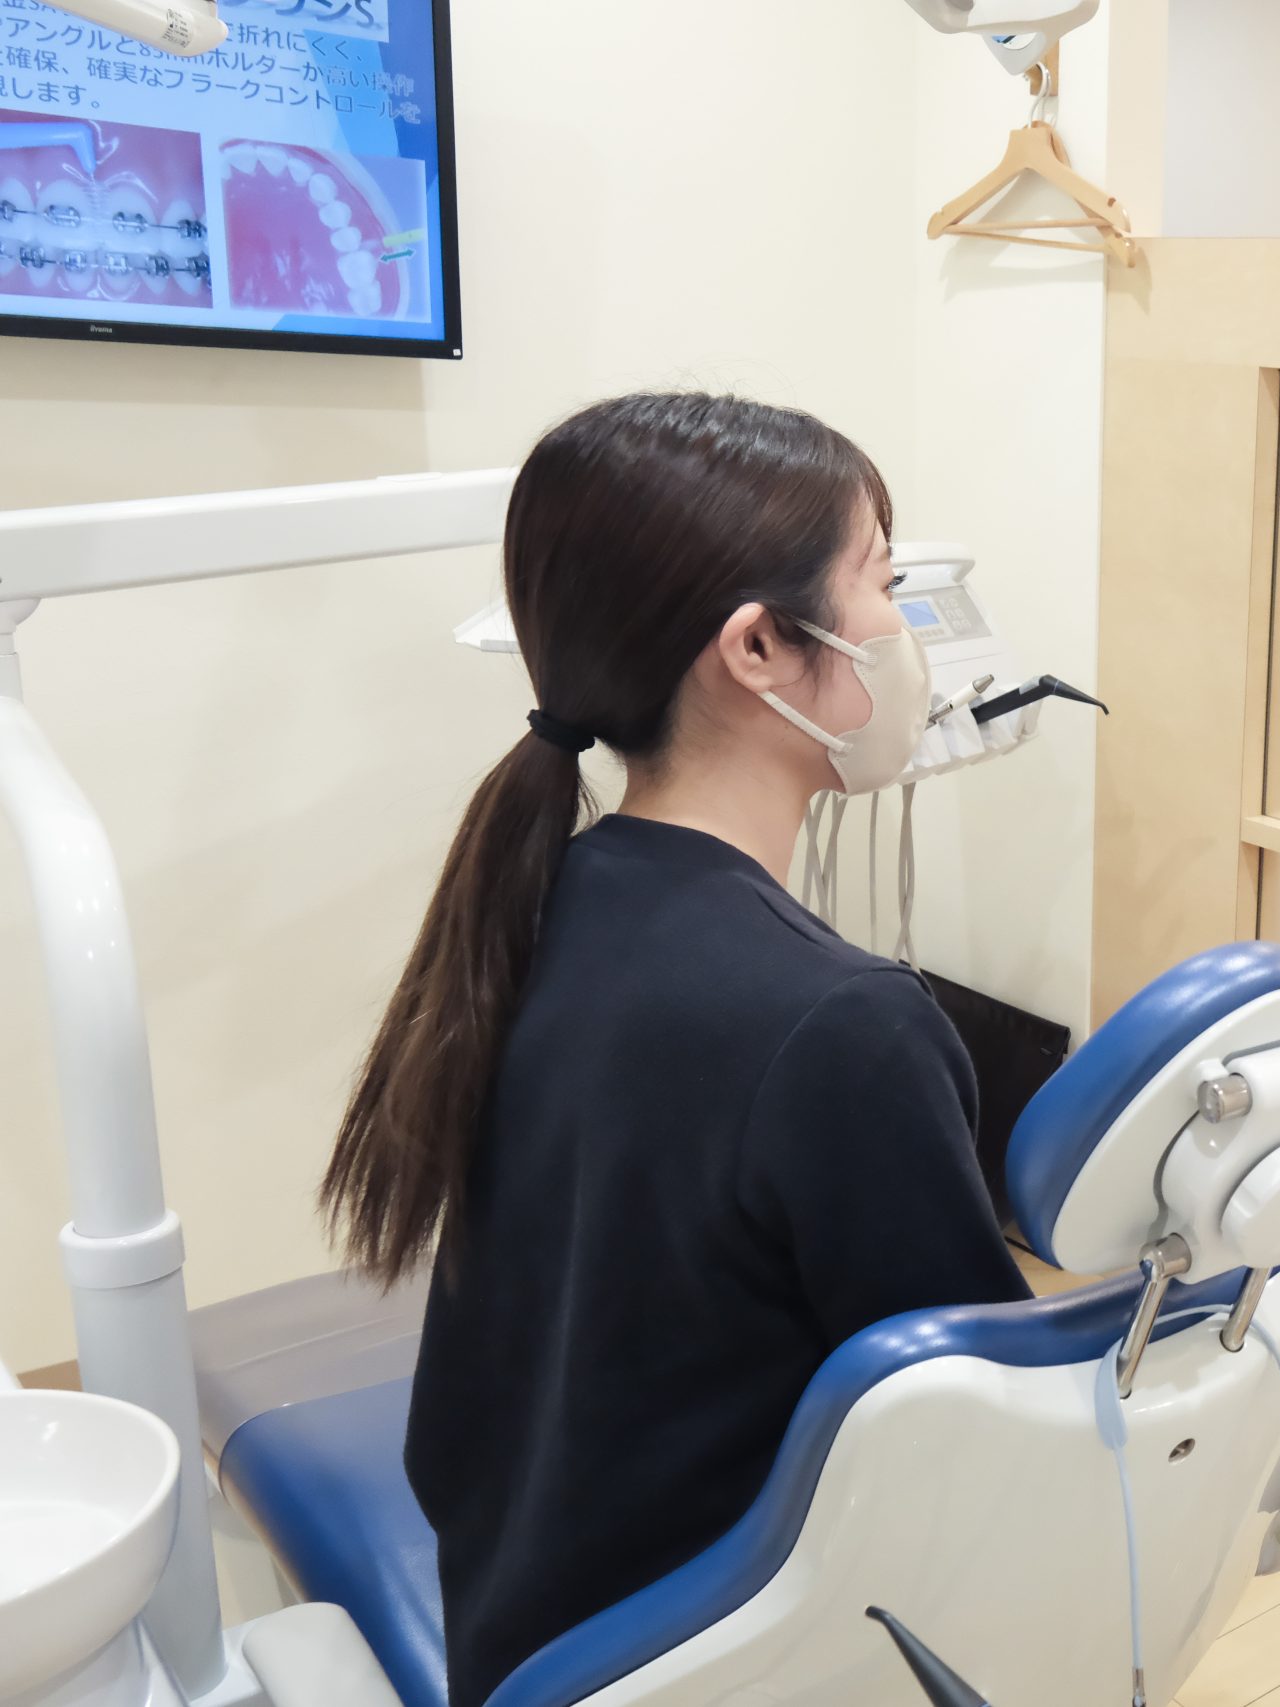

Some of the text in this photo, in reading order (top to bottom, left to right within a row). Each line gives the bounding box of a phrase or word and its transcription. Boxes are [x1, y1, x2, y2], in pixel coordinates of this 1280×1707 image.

[0, 45, 421, 125] 確保、確実なプラークコントロールを
